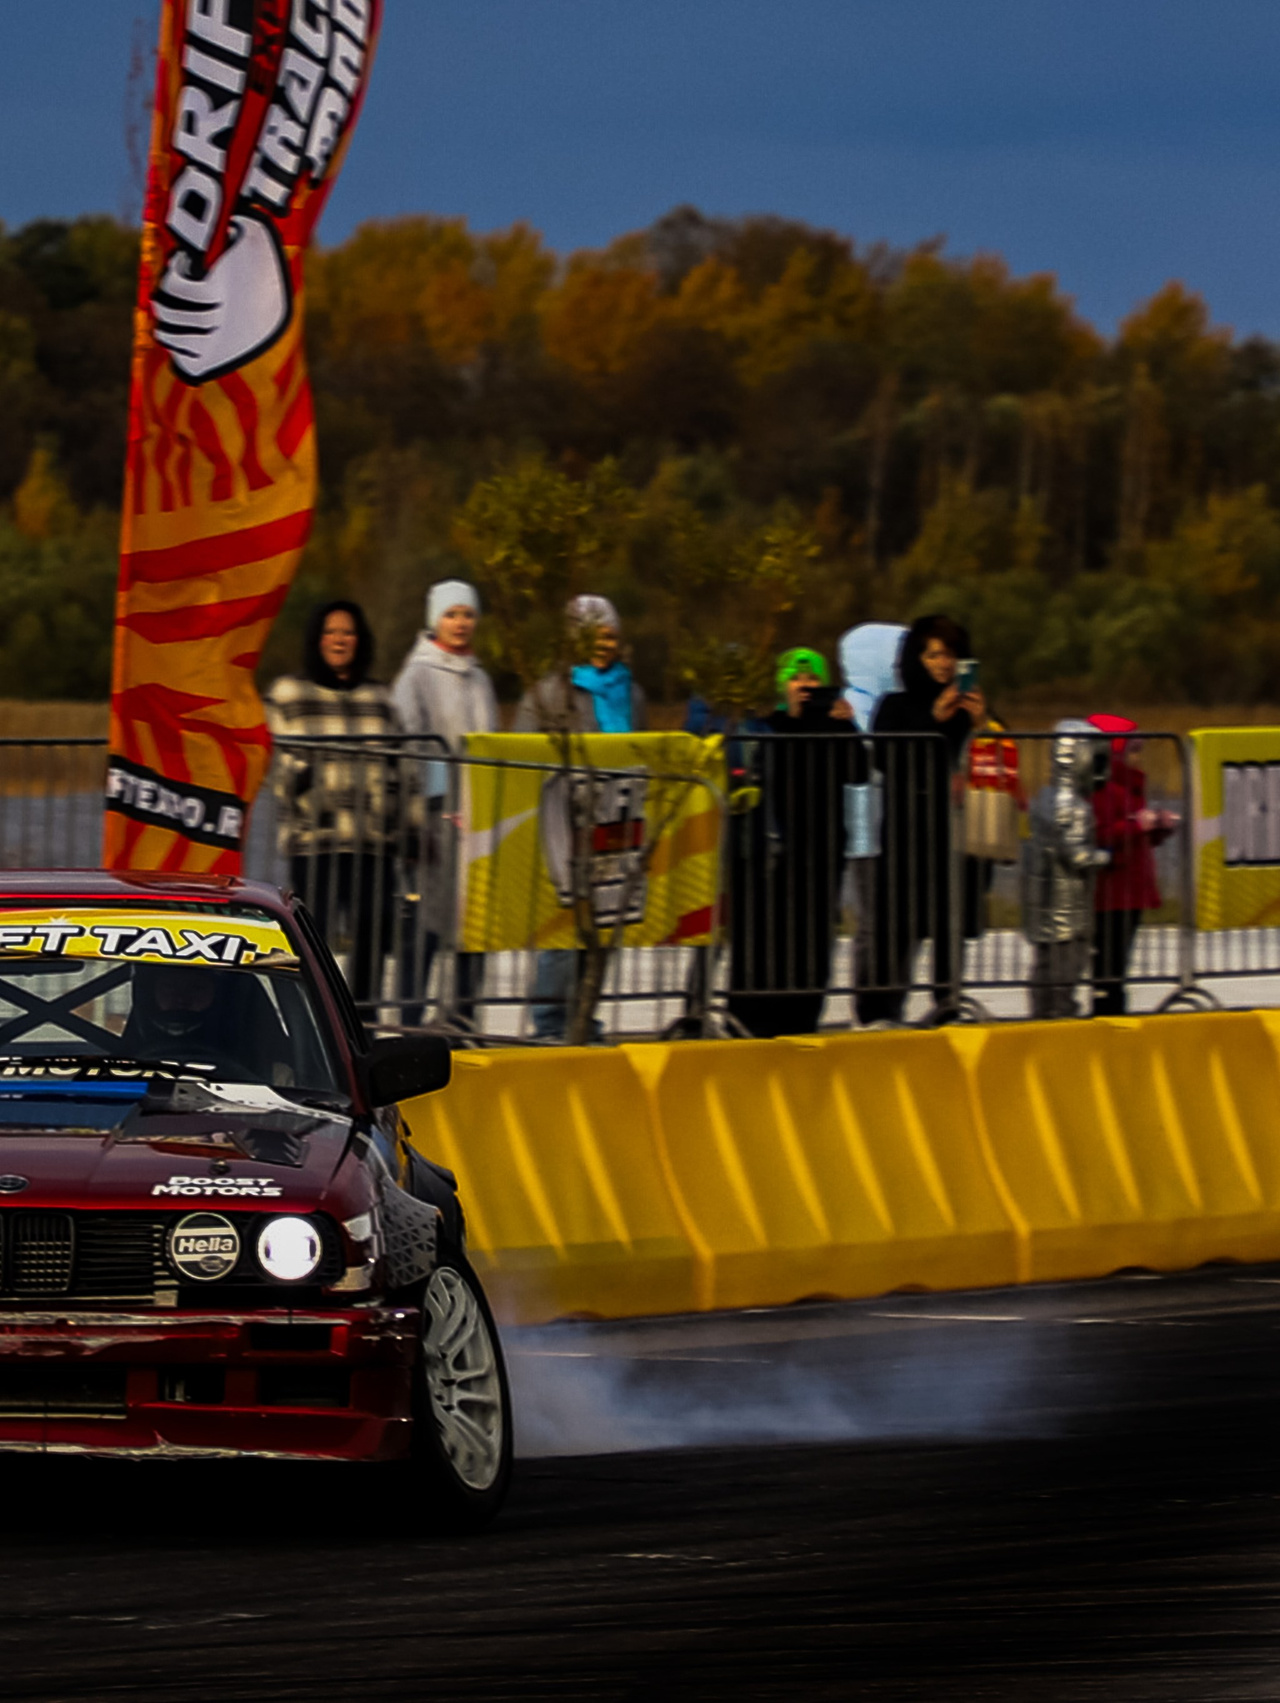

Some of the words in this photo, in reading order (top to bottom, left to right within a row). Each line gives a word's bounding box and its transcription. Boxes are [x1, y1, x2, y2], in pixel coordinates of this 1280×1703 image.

[240, 0, 331, 206] TRAC
[92, 927, 241, 961] TAXI
[168, 1176, 275, 1186] BOOST
[151, 1185, 284, 1197] MOTORS
[178, 1236, 234, 1253] Hella
